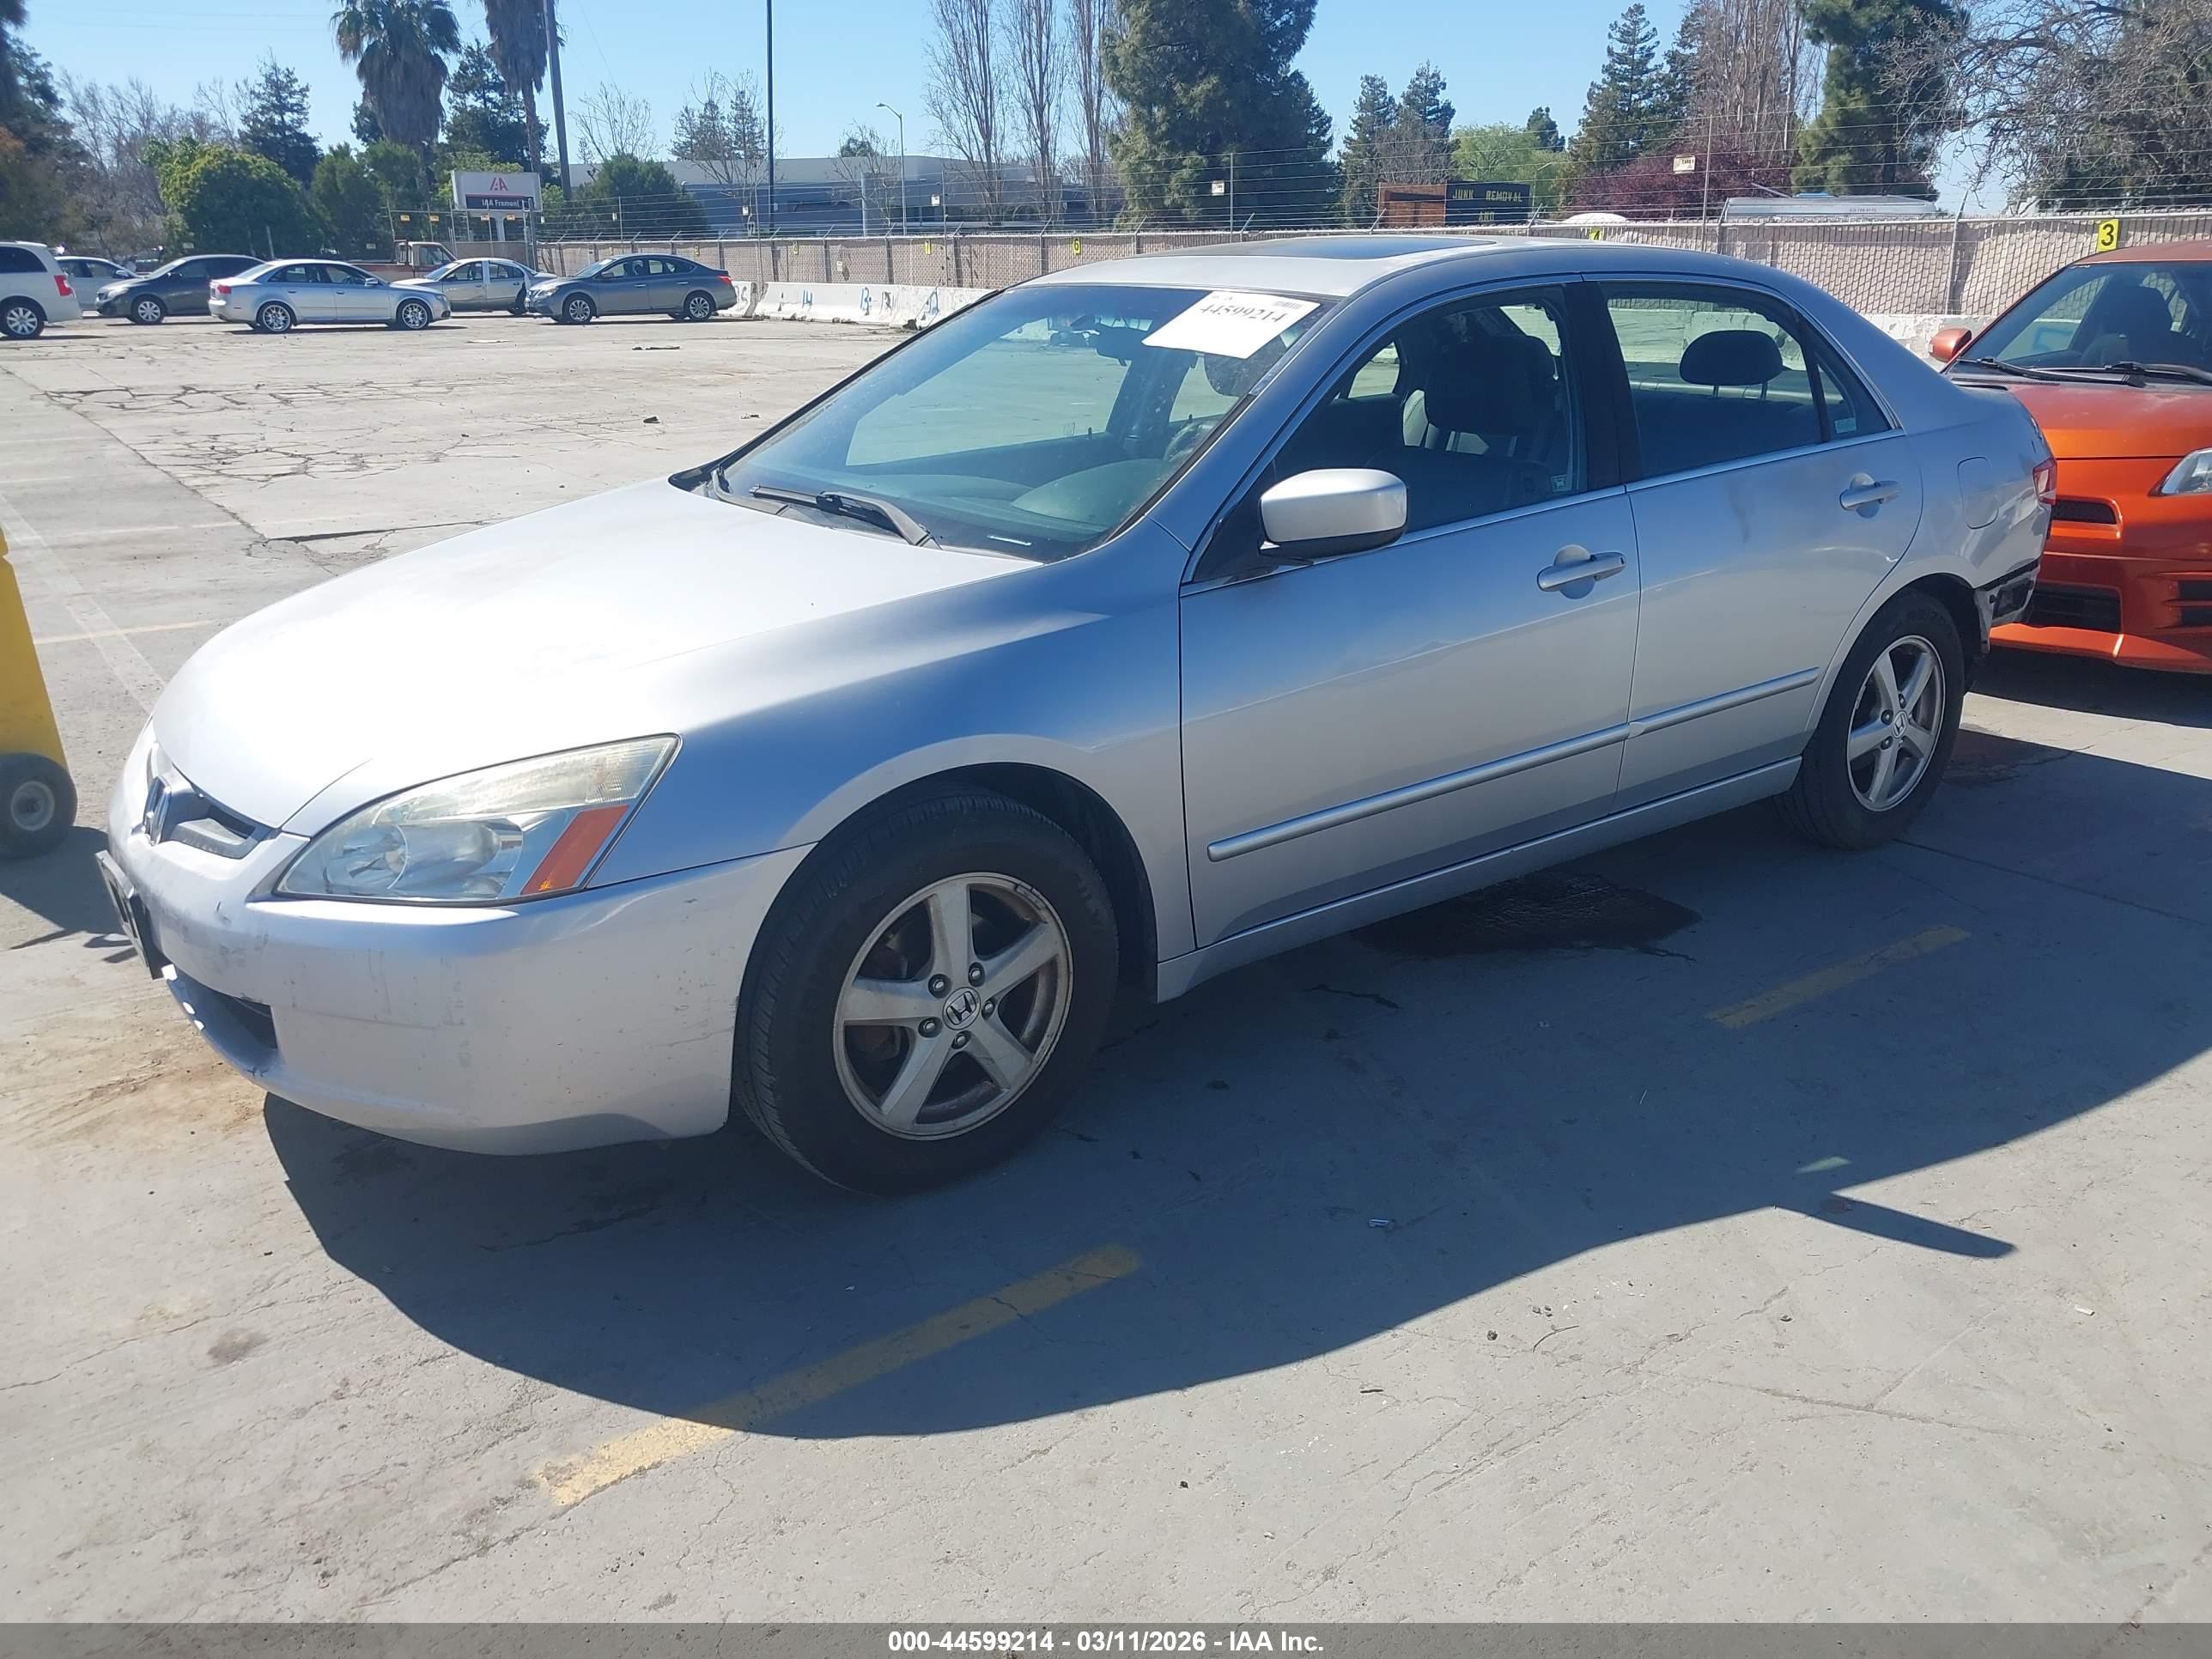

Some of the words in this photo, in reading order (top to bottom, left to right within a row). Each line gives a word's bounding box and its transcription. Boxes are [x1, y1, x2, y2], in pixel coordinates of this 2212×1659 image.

[1452, 188, 1474, 200] JUNK
[1486, 190, 1523, 203] REMOVAL
[2100, 223, 2115, 246] 3
[1073, 238, 1079, 251] 6
[1200, 303, 1289, 323] 44599214
